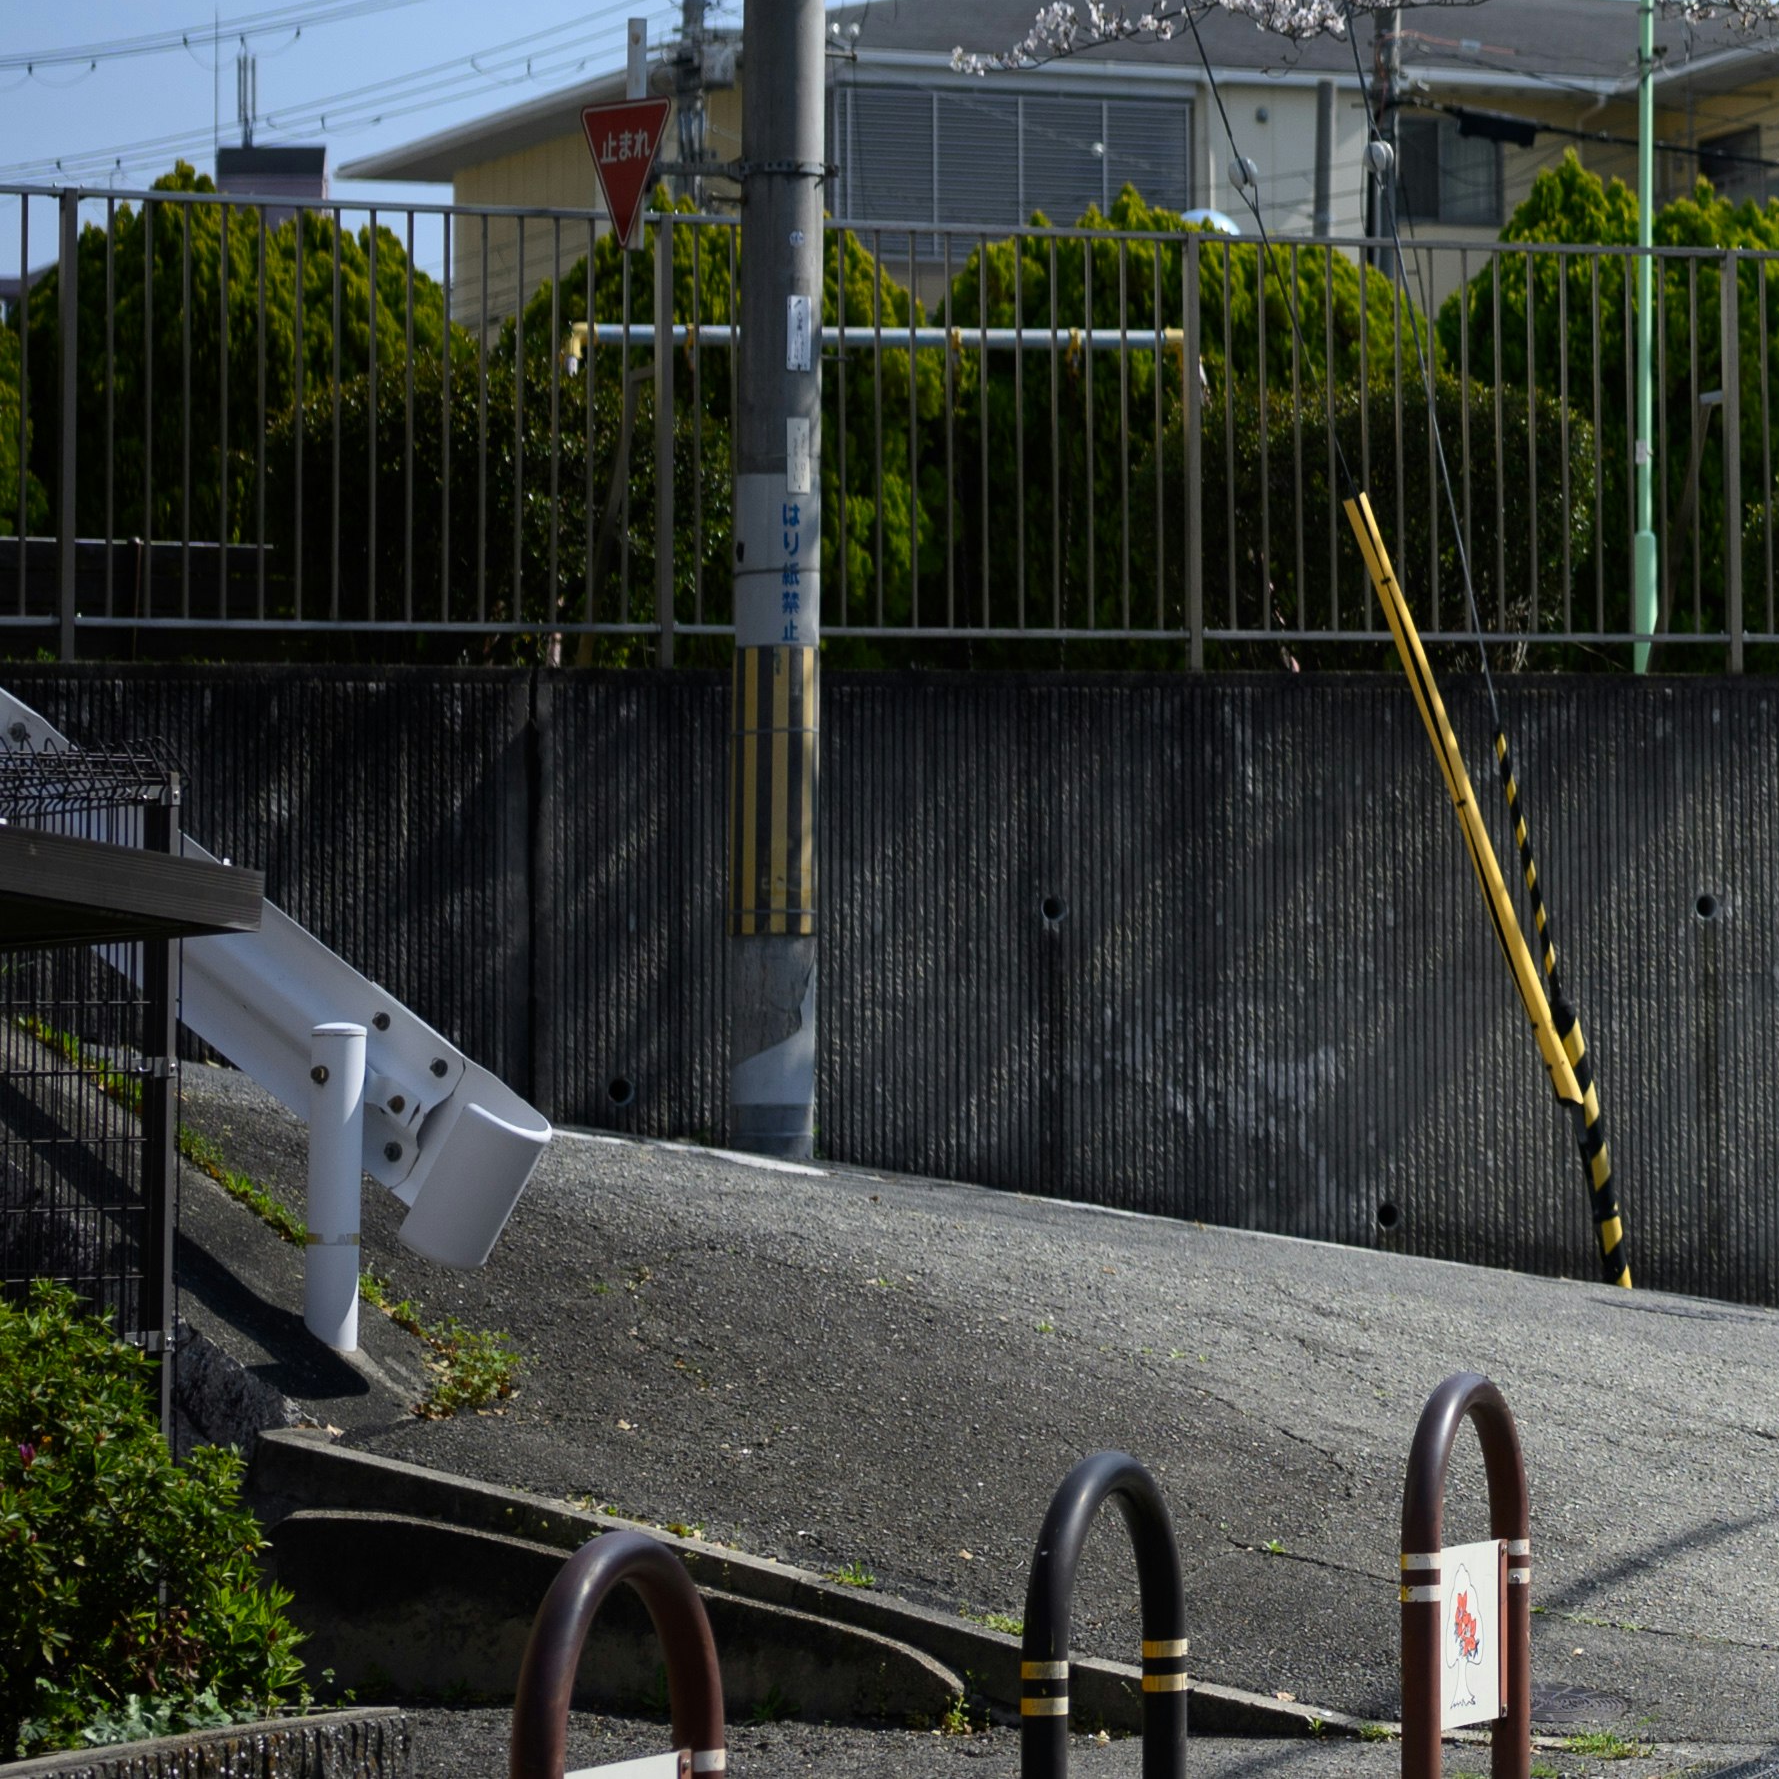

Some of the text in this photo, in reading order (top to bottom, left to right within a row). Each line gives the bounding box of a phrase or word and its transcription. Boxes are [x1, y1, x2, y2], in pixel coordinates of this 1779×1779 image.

[600, 128, 651, 165] 止まれ
[781, 502, 801, 643] はり紙禁止
